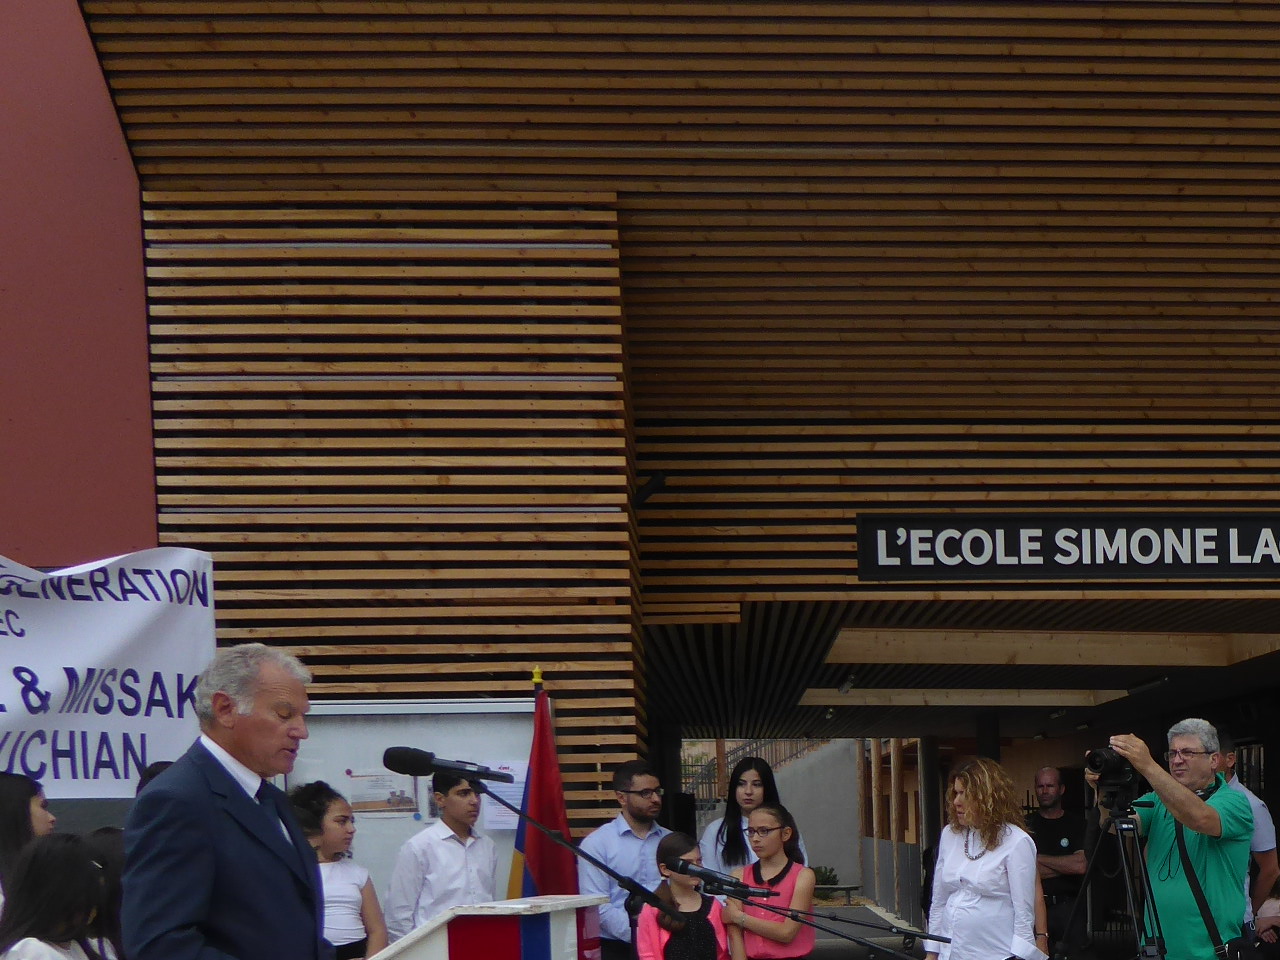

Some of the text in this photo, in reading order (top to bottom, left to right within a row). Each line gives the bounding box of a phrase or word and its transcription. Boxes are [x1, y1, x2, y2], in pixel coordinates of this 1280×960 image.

[877, 527, 1044, 566] L'ECOLE
[1054, 527, 1219, 566] SIMONE
[13, 666, 51, 715] &
